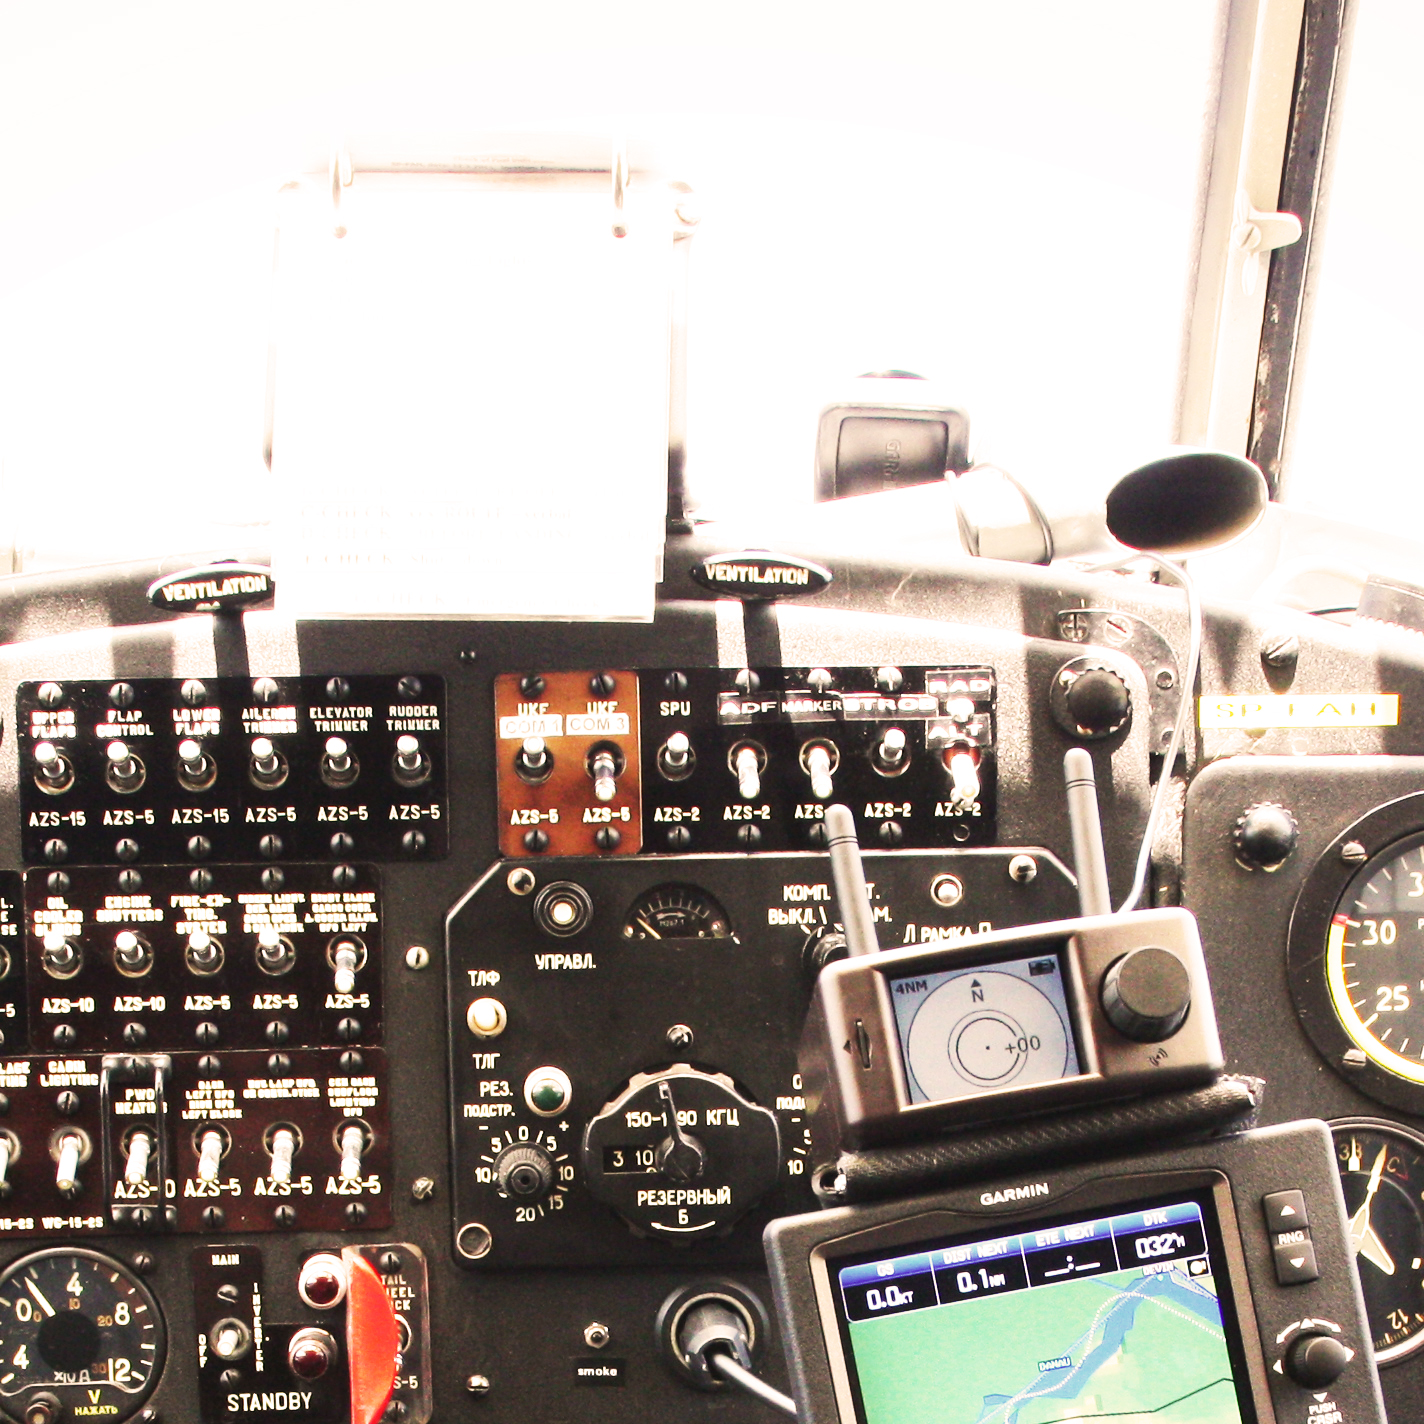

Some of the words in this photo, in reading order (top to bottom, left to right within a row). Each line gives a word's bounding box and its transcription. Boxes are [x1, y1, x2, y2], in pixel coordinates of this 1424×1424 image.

[704, 564, 809, 586] VENTILATION
[162, 574, 268, 602] VENTILATION
[241, 707, 296, 721] AILERON
[309, 707, 373, 720] ELEVATOR
[389, 705, 438, 718] RUDDER
[517, 703, 549, 715] UKF
[587, 701, 619, 714] UKF
[660, 701, 691, 716] SPU
[719, 701, 777, 716] ADF
[781, 700, 842, 713] MARKER
[31, 710, 75, 725] UPPER
[107, 710, 143, 723] FLAP
[173, 707, 221, 722] LOWER
[31, 725, 76, 738] FLAPS
[96, 724, 154, 737] CONTROL
[175, 722, 220, 735] FLAPS
[314, 720, 369, 733] TRIMMER
[386, 719, 440, 731] TRIMMER
[506, 720, 546, 734] COM
[570, 717, 610, 732] COM
[103, 809, 155, 825] AZS-5
[171, 808, 230, 824] AZS-15
[245, 806, 297, 823] AZS-5
[317, 805, 369, 821] AZS-5
[388, 804, 441, 820] AZS-5
[510, 809, 560, 825] AZS-5
[582, 807, 631, 823] AZS-5
[654, 807, 701, 822] AZS-2
[723, 805, 771, 820] AZS-2
[864, 803, 912, 818] AZS-2
[29, 811, 86, 827] AZS-15
[784, 884, 831, 901] КОМП.
[33, 910, 84, 923] COOLER
[768, 907, 816, 925] ВЫКЛ.
[1362, 919, 1396, 945] 30
[535, 953, 597, 970] УПРАВЛ.
[468, 970, 501, 986] ТЛФ
[895, 981, 928, 996] 4NM
[42, 997, 95, 1014] AZS-10
[114, 996, 166, 1012] AZS-10
[184, 995, 232, 1011] AZS-5
[253, 994, 299, 1010] AZS-5
[325, 993, 371, 1009] AZS-5
[1376, 985, 1411, 1011] 25
[48, 1060, 87, 1074] CABIN
[473, 1053, 501, 1070] ТЛГ
[40, 1074, 99, 1087] LIGHTING
[480, 1081, 514, 1098] РЕЗ.
[464, 1103, 516, 1118] ПОДСТР.
[559, 1165, 574, 1180] 10
[184, 1178, 242, 1198] AZS-5
[254, 1176, 313, 1196] AZS-5
[325, 1175, 382, 1195] AZS-5
[637, 1186, 731, 1206] РЕЗЕРВНЫЙ
[980, 1183, 1049, 1206] GARMIN
[516, 1207, 536, 1222] 20
[1143, 1211, 1167, 1227] DTK
[1035, 1231, 1061, 1248] ETE
[1064, 1224, 1095, 1242] NEXT
[1278, 1230, 1304, 1245] RNG
[943, 1248, 972, 1264] DIST
[976, 1240, 1008, 1258] NEXT
[211, 1254, 240, 1266] MAIN
[97, 1315, 113, 1327] 20
[107, 1358, 131, 1382] 12
[577, 1366, 617, 1377] smoke
[227, 1392, 312, 1412] STANDBY
[1309, 1402, 1337, 1415] PUSH
[74, 1405, 118, 1416] НАЖАТЬ
